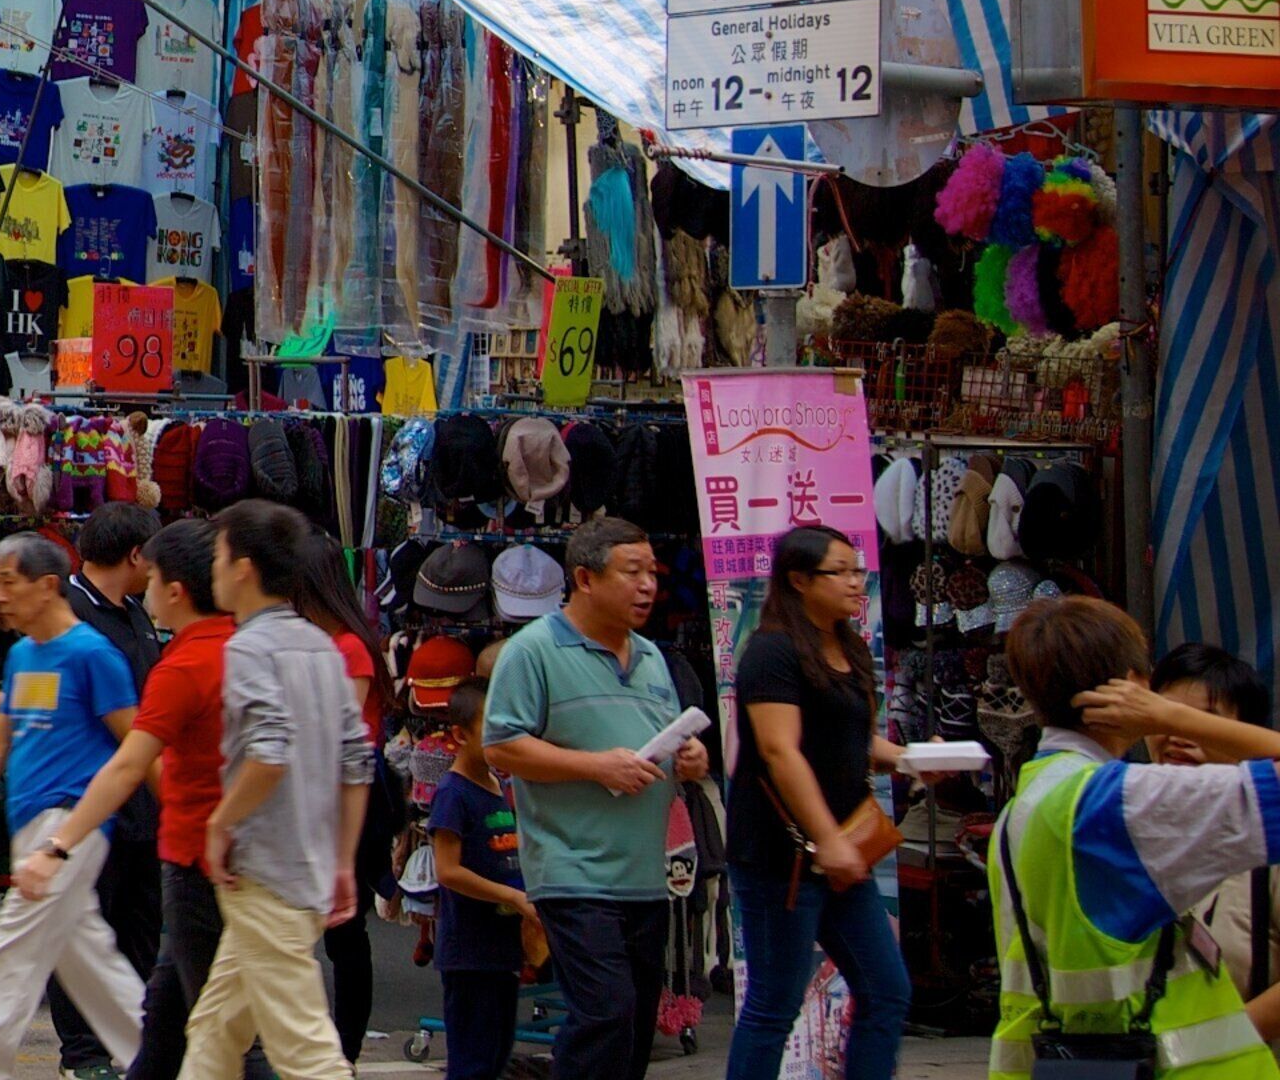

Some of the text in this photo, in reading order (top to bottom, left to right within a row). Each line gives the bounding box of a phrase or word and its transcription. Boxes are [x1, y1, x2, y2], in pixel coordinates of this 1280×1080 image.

[712, 13, 831, 36] General Holidays
[1153, 23, 1276, 48] VITA GREEN
[731, 38, 808, 65] 公眾假期
[672, 77, 704, 91] noon
[767, 64, 830, 85] midnight
[837, 65, 873, 102] 12
[673, 91, 815, 119] 中午 午夜
[158, 229, 203, 249] HONG
[157, 250, 202, 267] KONG
[12, 289, 21, 312] I
[7, 311, 44, 335] HK
[550, 326, 594, 377] $69
[333, 379, 365, 393] HNG
[333, 395, 366, 411] KNG
[705, 469, 864, 534] 買一送一
[711, 580, 737, 719] 可改尺寸
